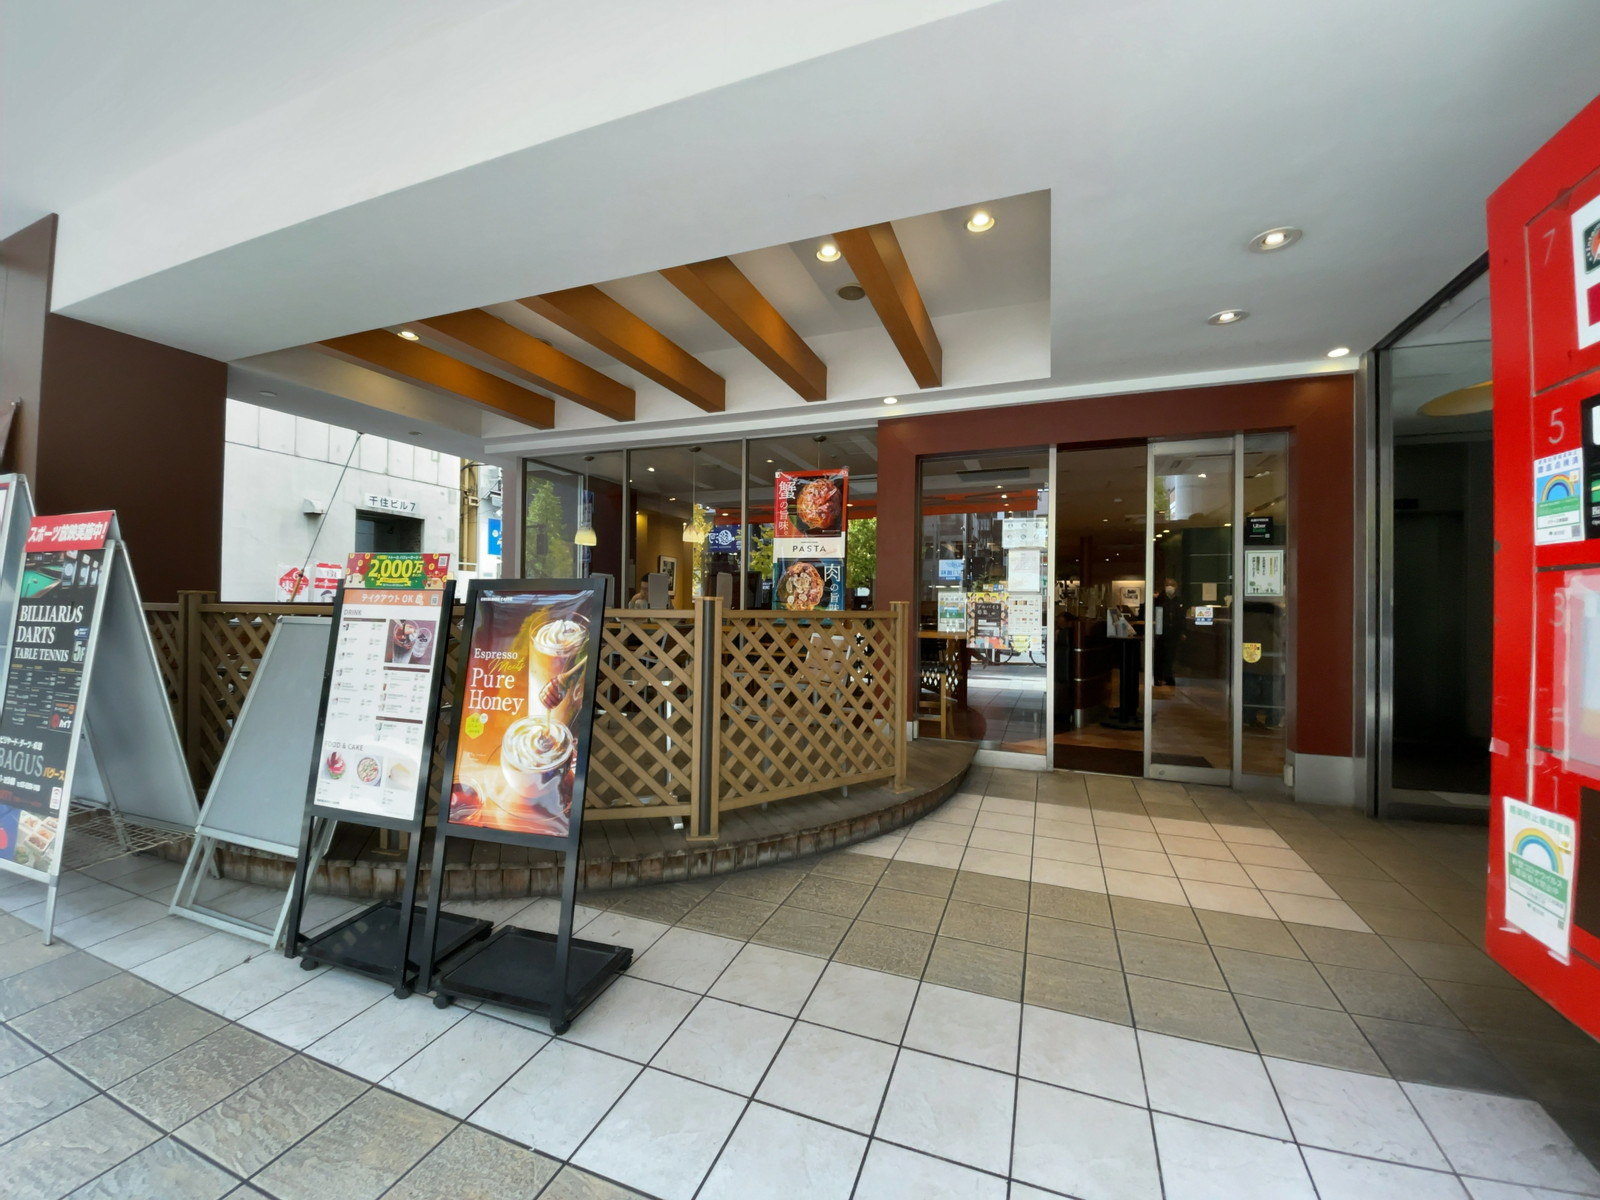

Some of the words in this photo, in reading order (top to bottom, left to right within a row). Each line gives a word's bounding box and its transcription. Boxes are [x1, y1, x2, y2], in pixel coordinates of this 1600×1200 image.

[1548, 408, 1565, 444] 5
[369, 495, 416, 511] 千住ビル7
[778, 481, 797, 536] 蟹の旨味。
[792, 545, 827, 553] PASTA
[368, 559, 425, 580] 2,000万
[361, 593, 400, 603] テイクアウト
[402, 594, 414, 603] OK
[19, 604, 84, 623] BILLIARDS
[16, 625, 56, 644] DARTS
[14, 647, 38, 660] TABLE
[39, 648, 70, 662] TENNIS
[73, 640, 86, 662] 5F
[474, 647, 518, 660] Espresso
[488, 657, 525, 676] Meets
[470, 667, 515, 689] Pure
[468, 689, 524, 716] Honey
[0, 747, 44, 777] BAGUS
